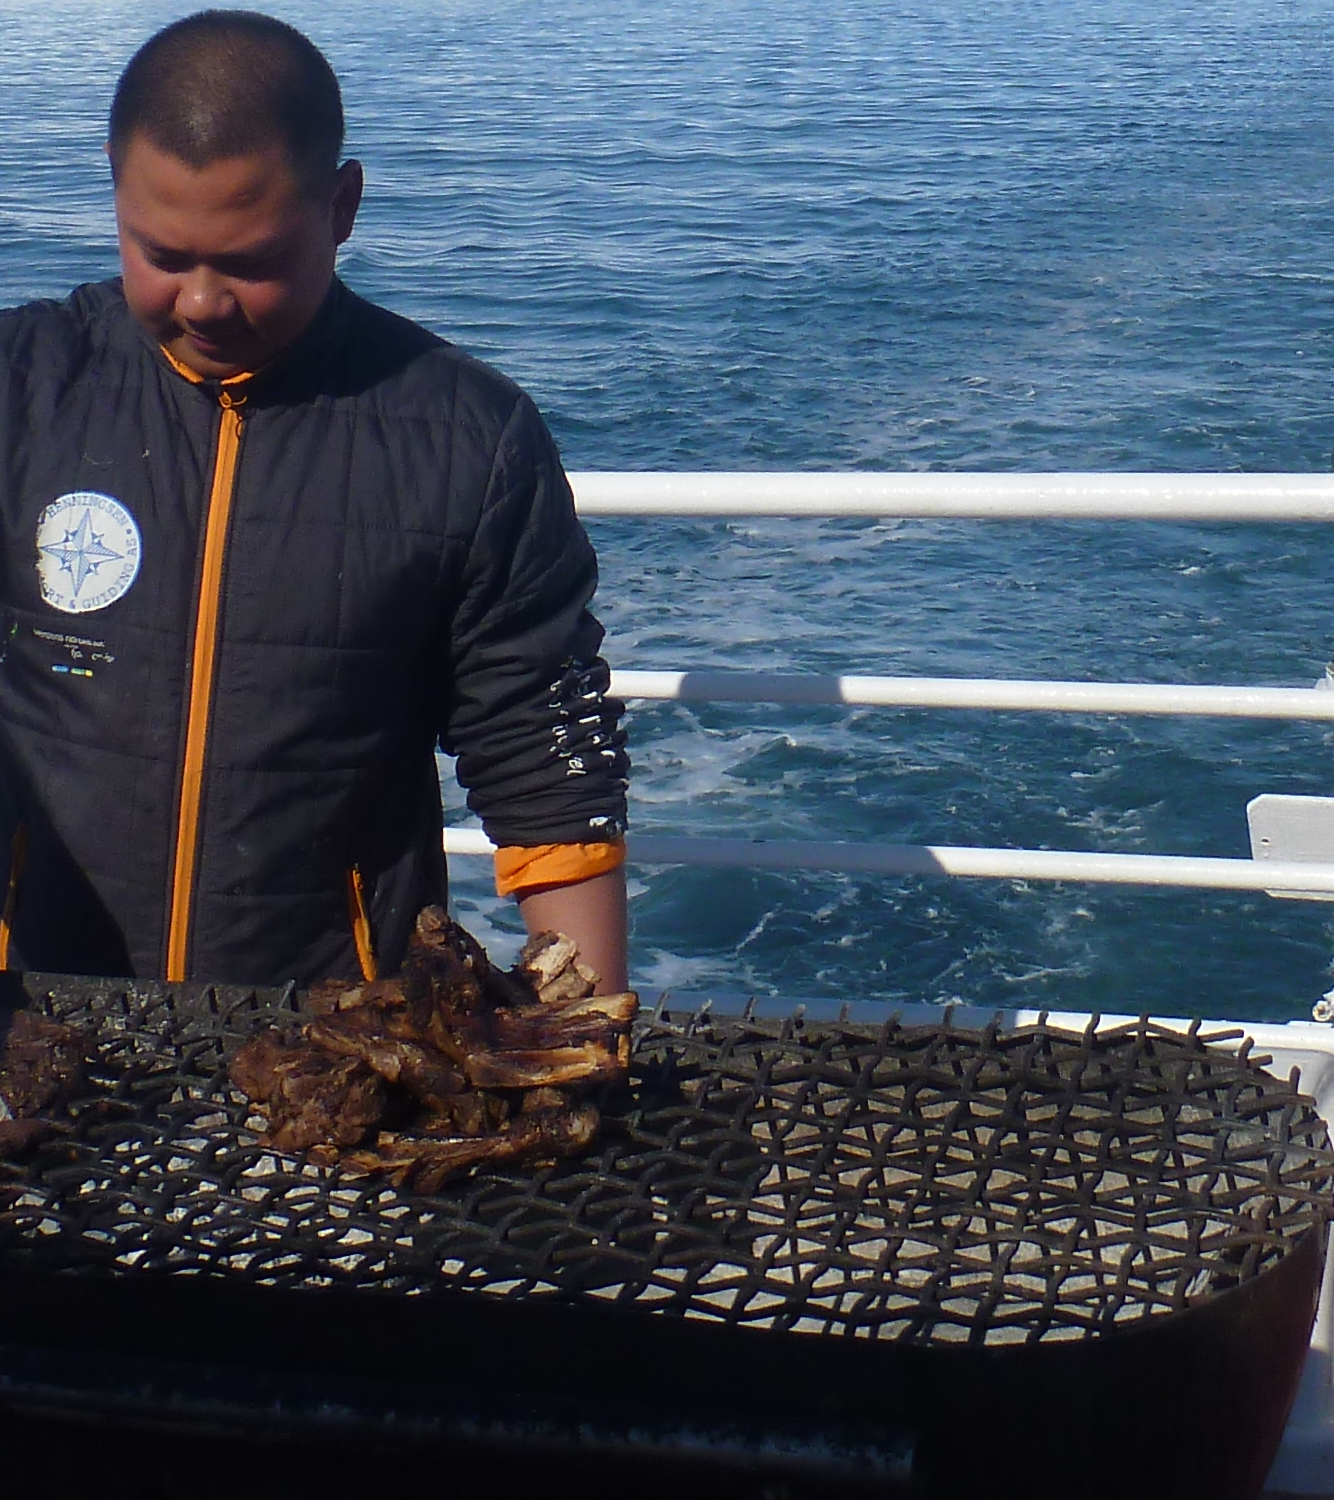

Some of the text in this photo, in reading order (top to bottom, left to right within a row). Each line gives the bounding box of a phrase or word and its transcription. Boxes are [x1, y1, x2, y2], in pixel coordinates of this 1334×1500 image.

[46, 495, 128, 527] HENNINGSEN
[83, 563, 134, 609] GUIDING
[127, 538, 137, 556] AS
